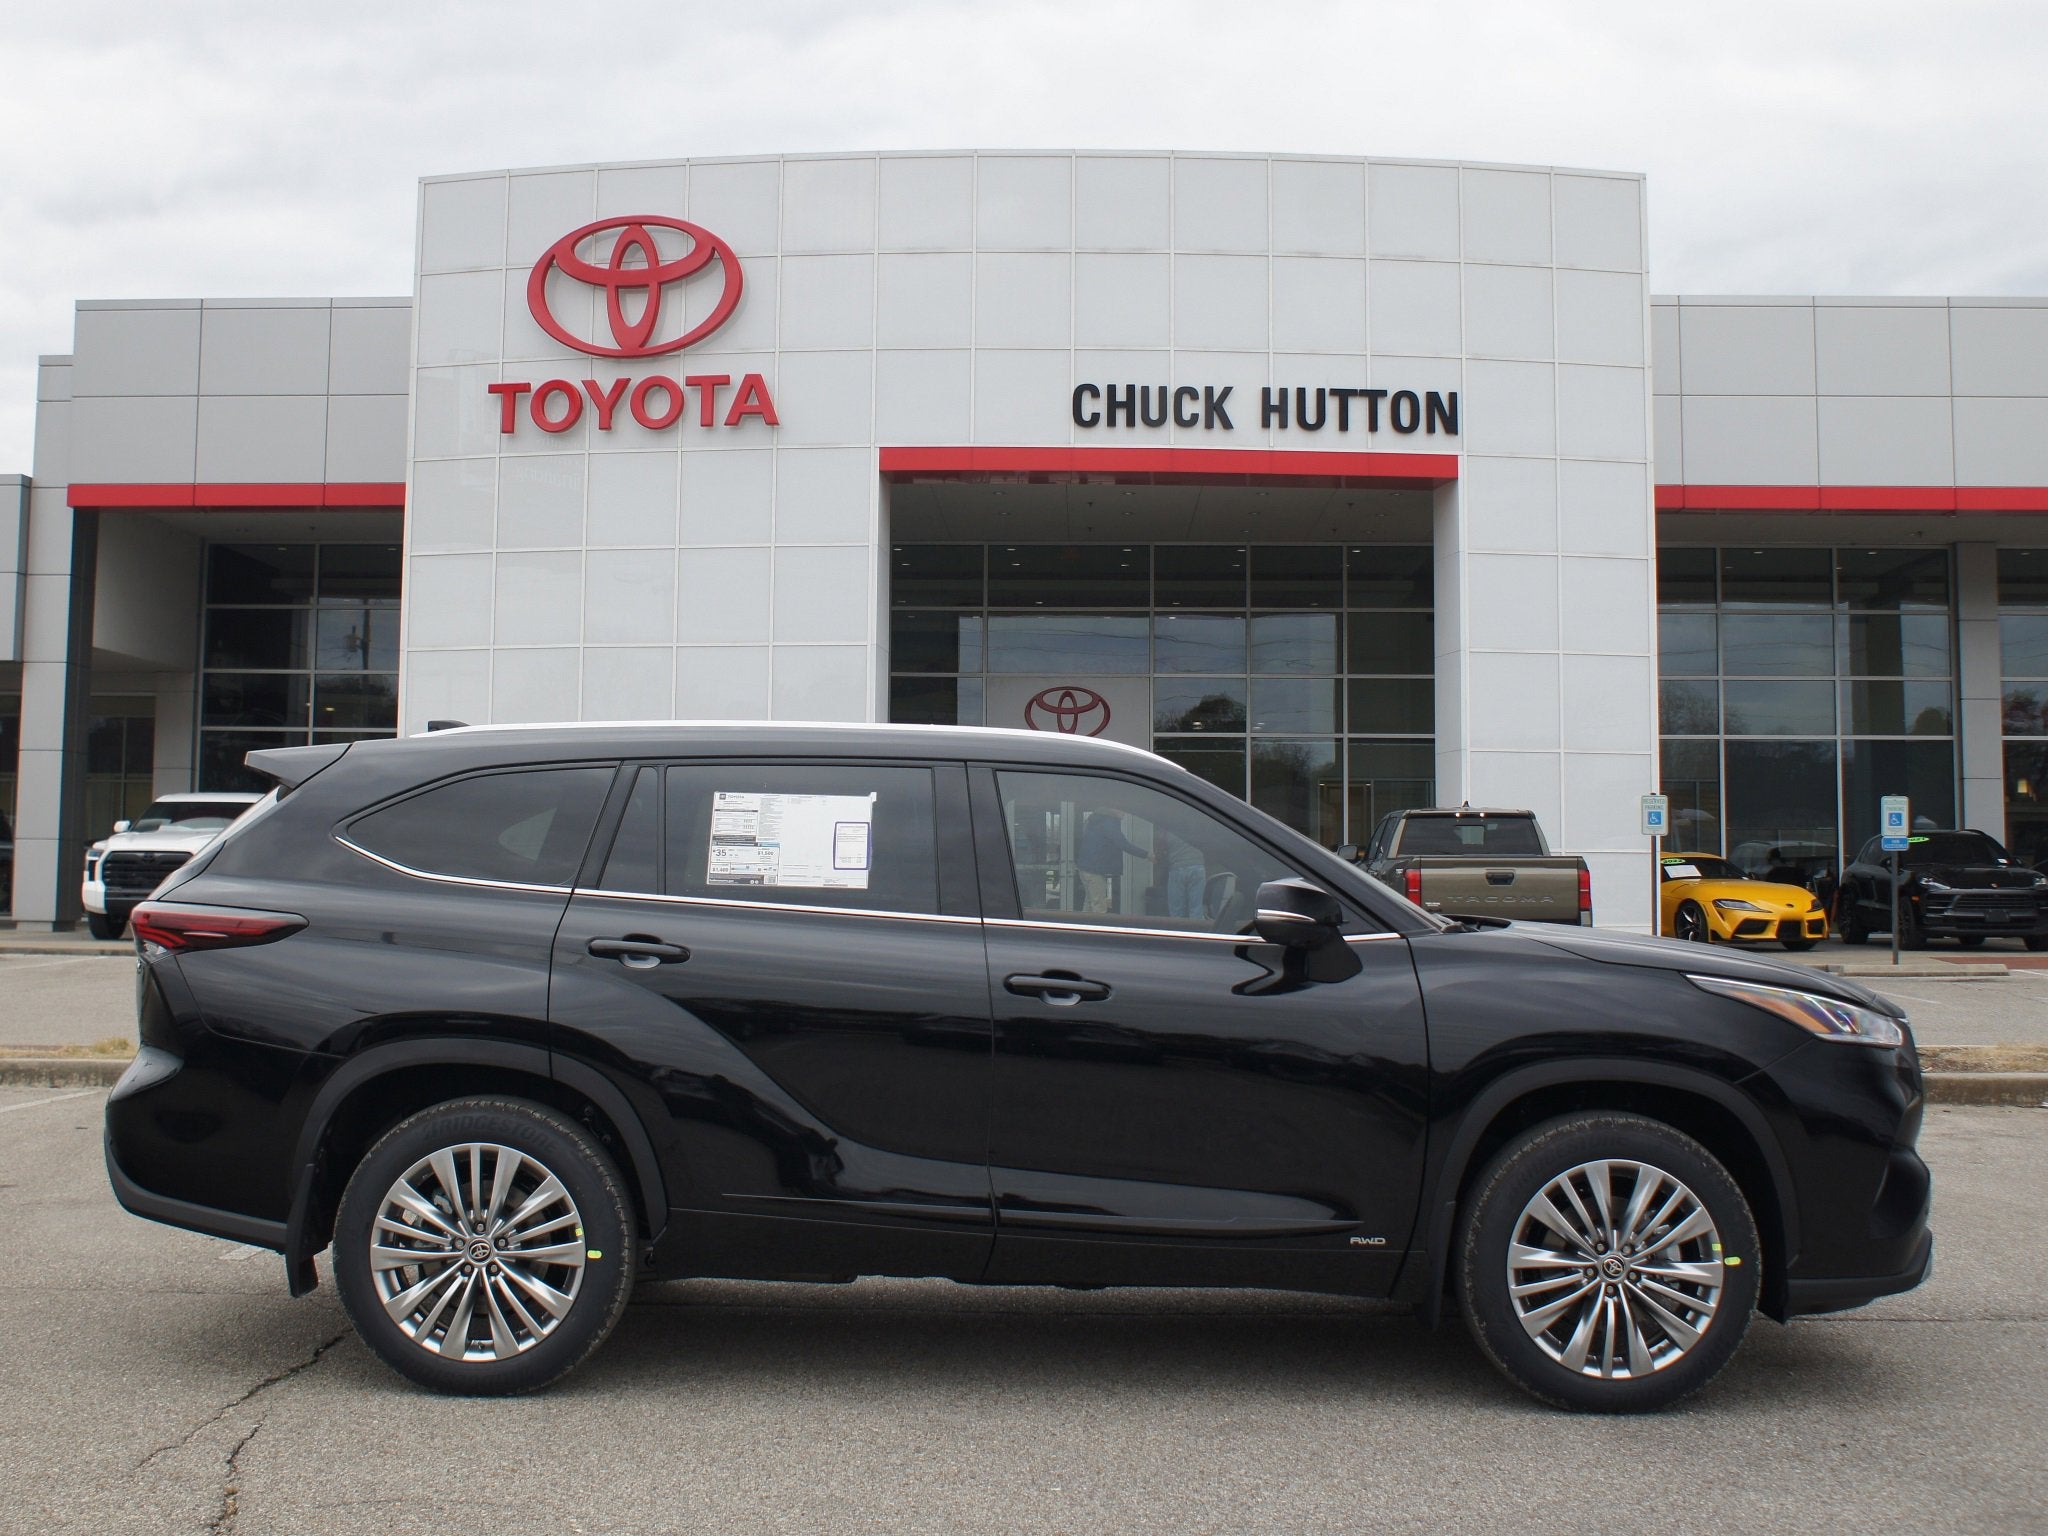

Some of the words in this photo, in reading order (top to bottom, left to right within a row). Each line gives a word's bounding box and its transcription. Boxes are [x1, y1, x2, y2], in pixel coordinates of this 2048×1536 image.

[487, 373, 780, 434] TOYOTA
[1072, 383, 1235, 430] CHUCK
[1260, 386, 1459, 435] HUTTON
[715, 849, 727, 857] 35
[1349, 1236, 1387, 1245] AWD
